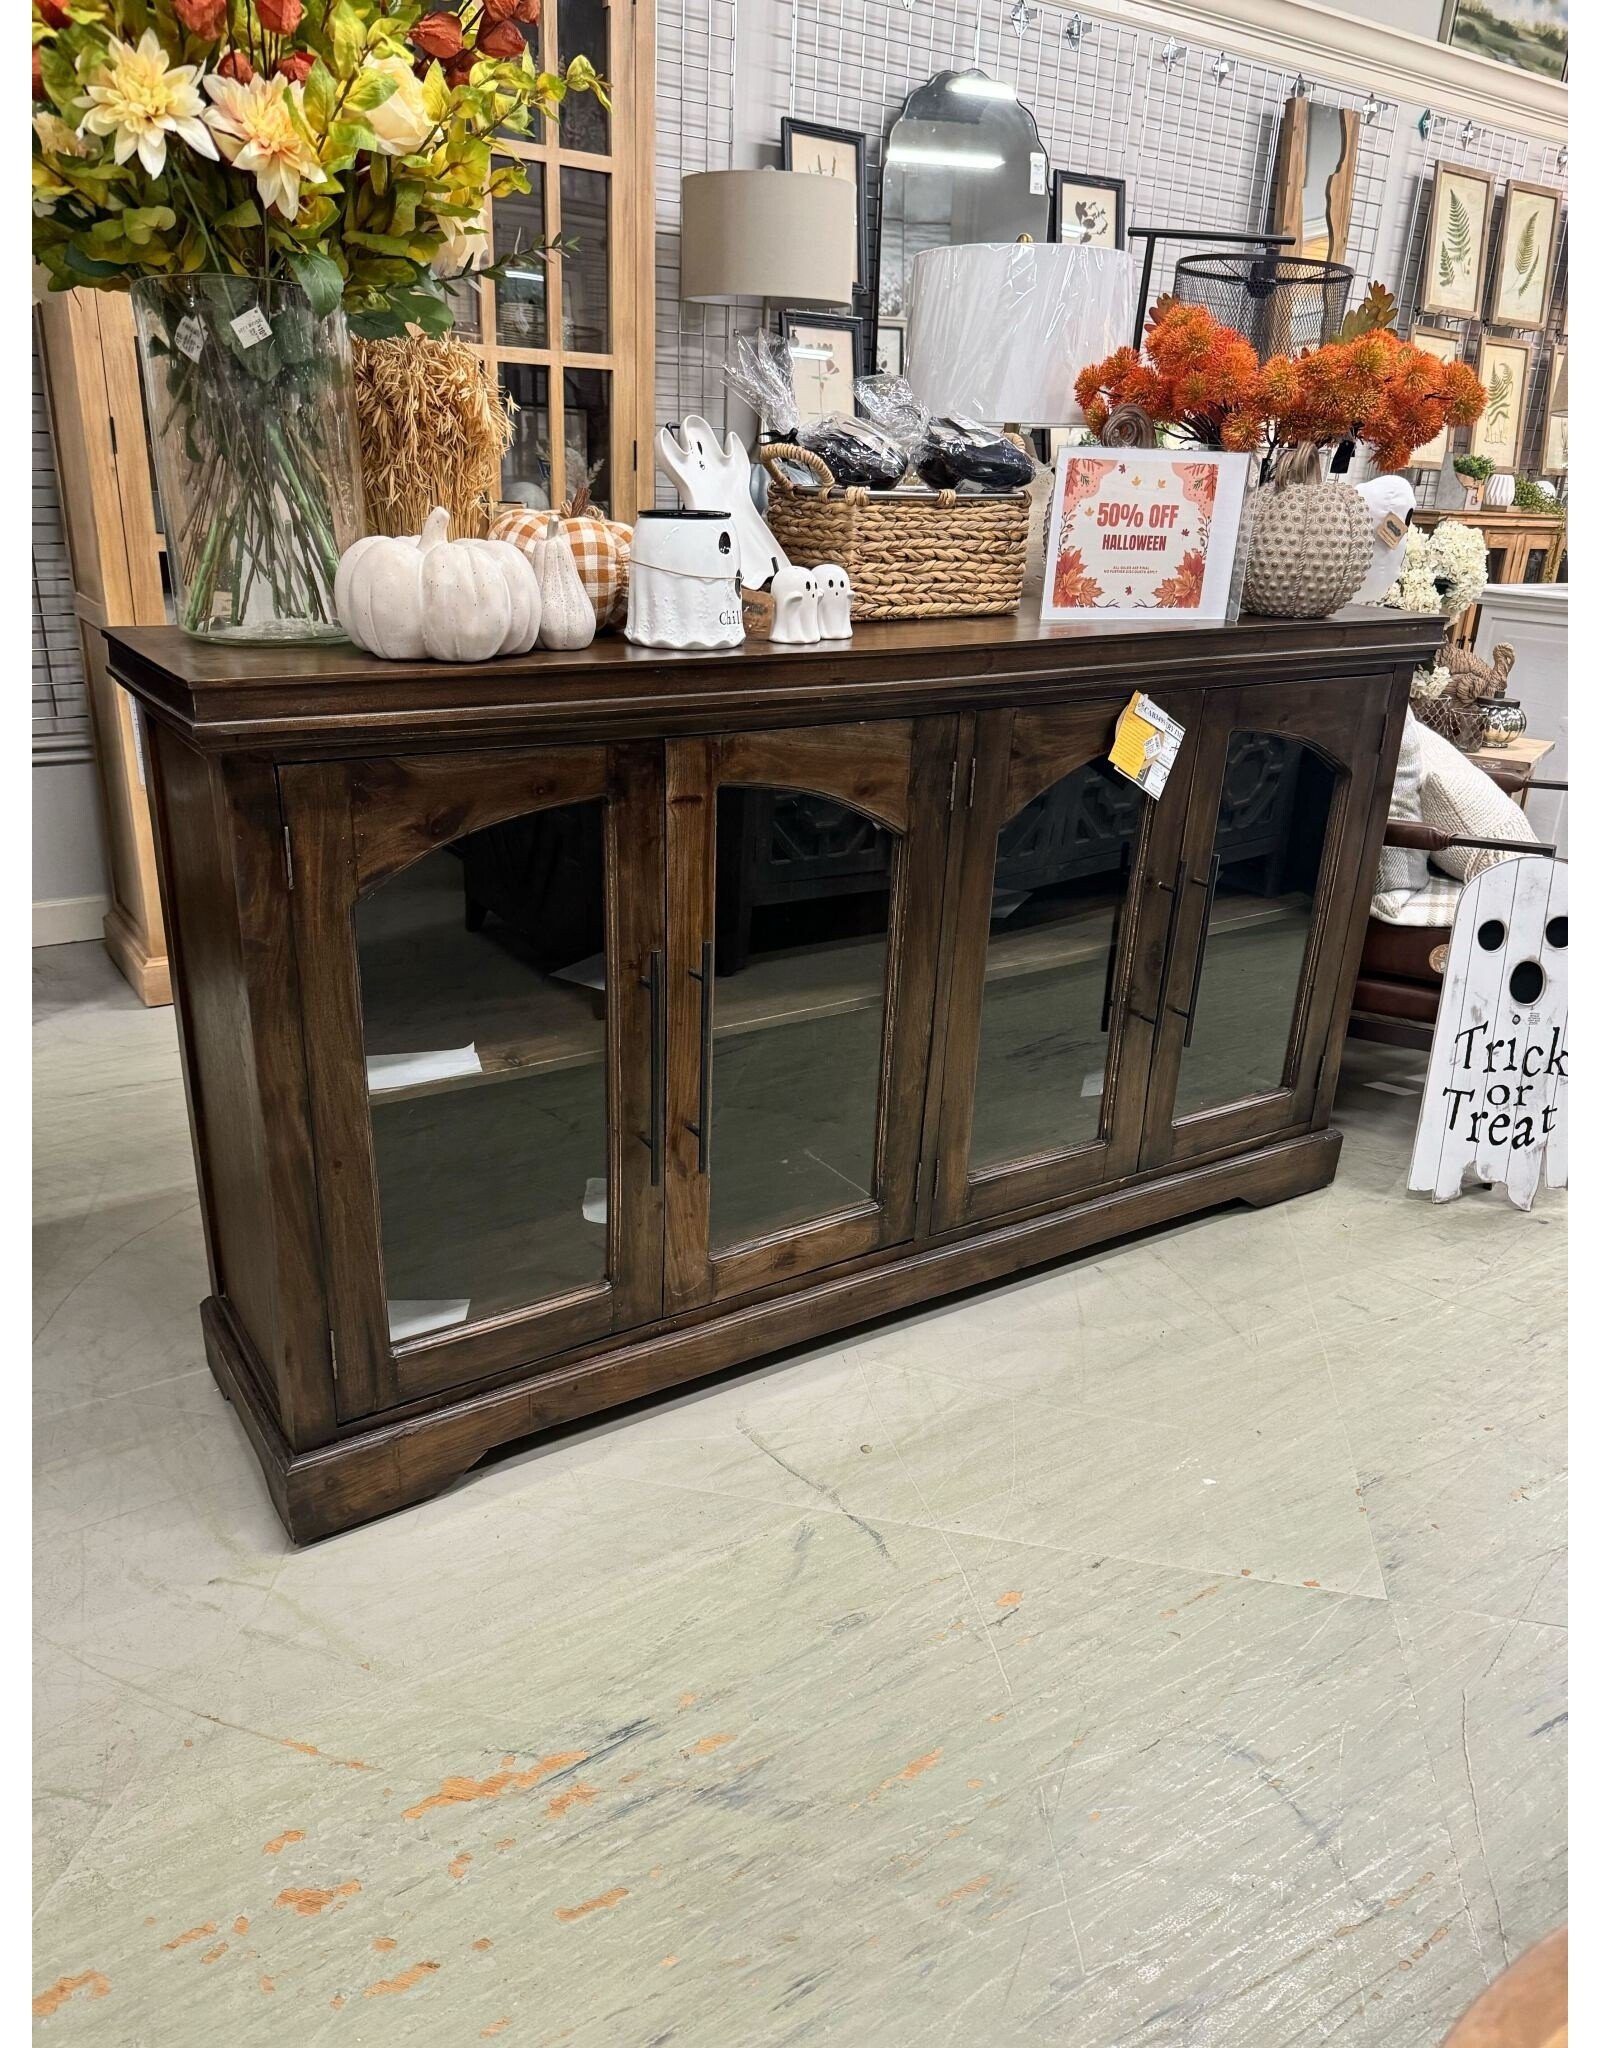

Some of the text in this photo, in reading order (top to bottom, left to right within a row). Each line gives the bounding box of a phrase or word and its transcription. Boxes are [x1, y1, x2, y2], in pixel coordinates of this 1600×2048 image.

[1097, 502, 1179, 528] 50% OFF
[1102, 534, 1167, 551] HALLOWEEN
[1454, 1020, 1568, 1077] Trick
[1486, 1084, 1534, 1106] or
[1442, 1087, 1558, 1150] Treat
